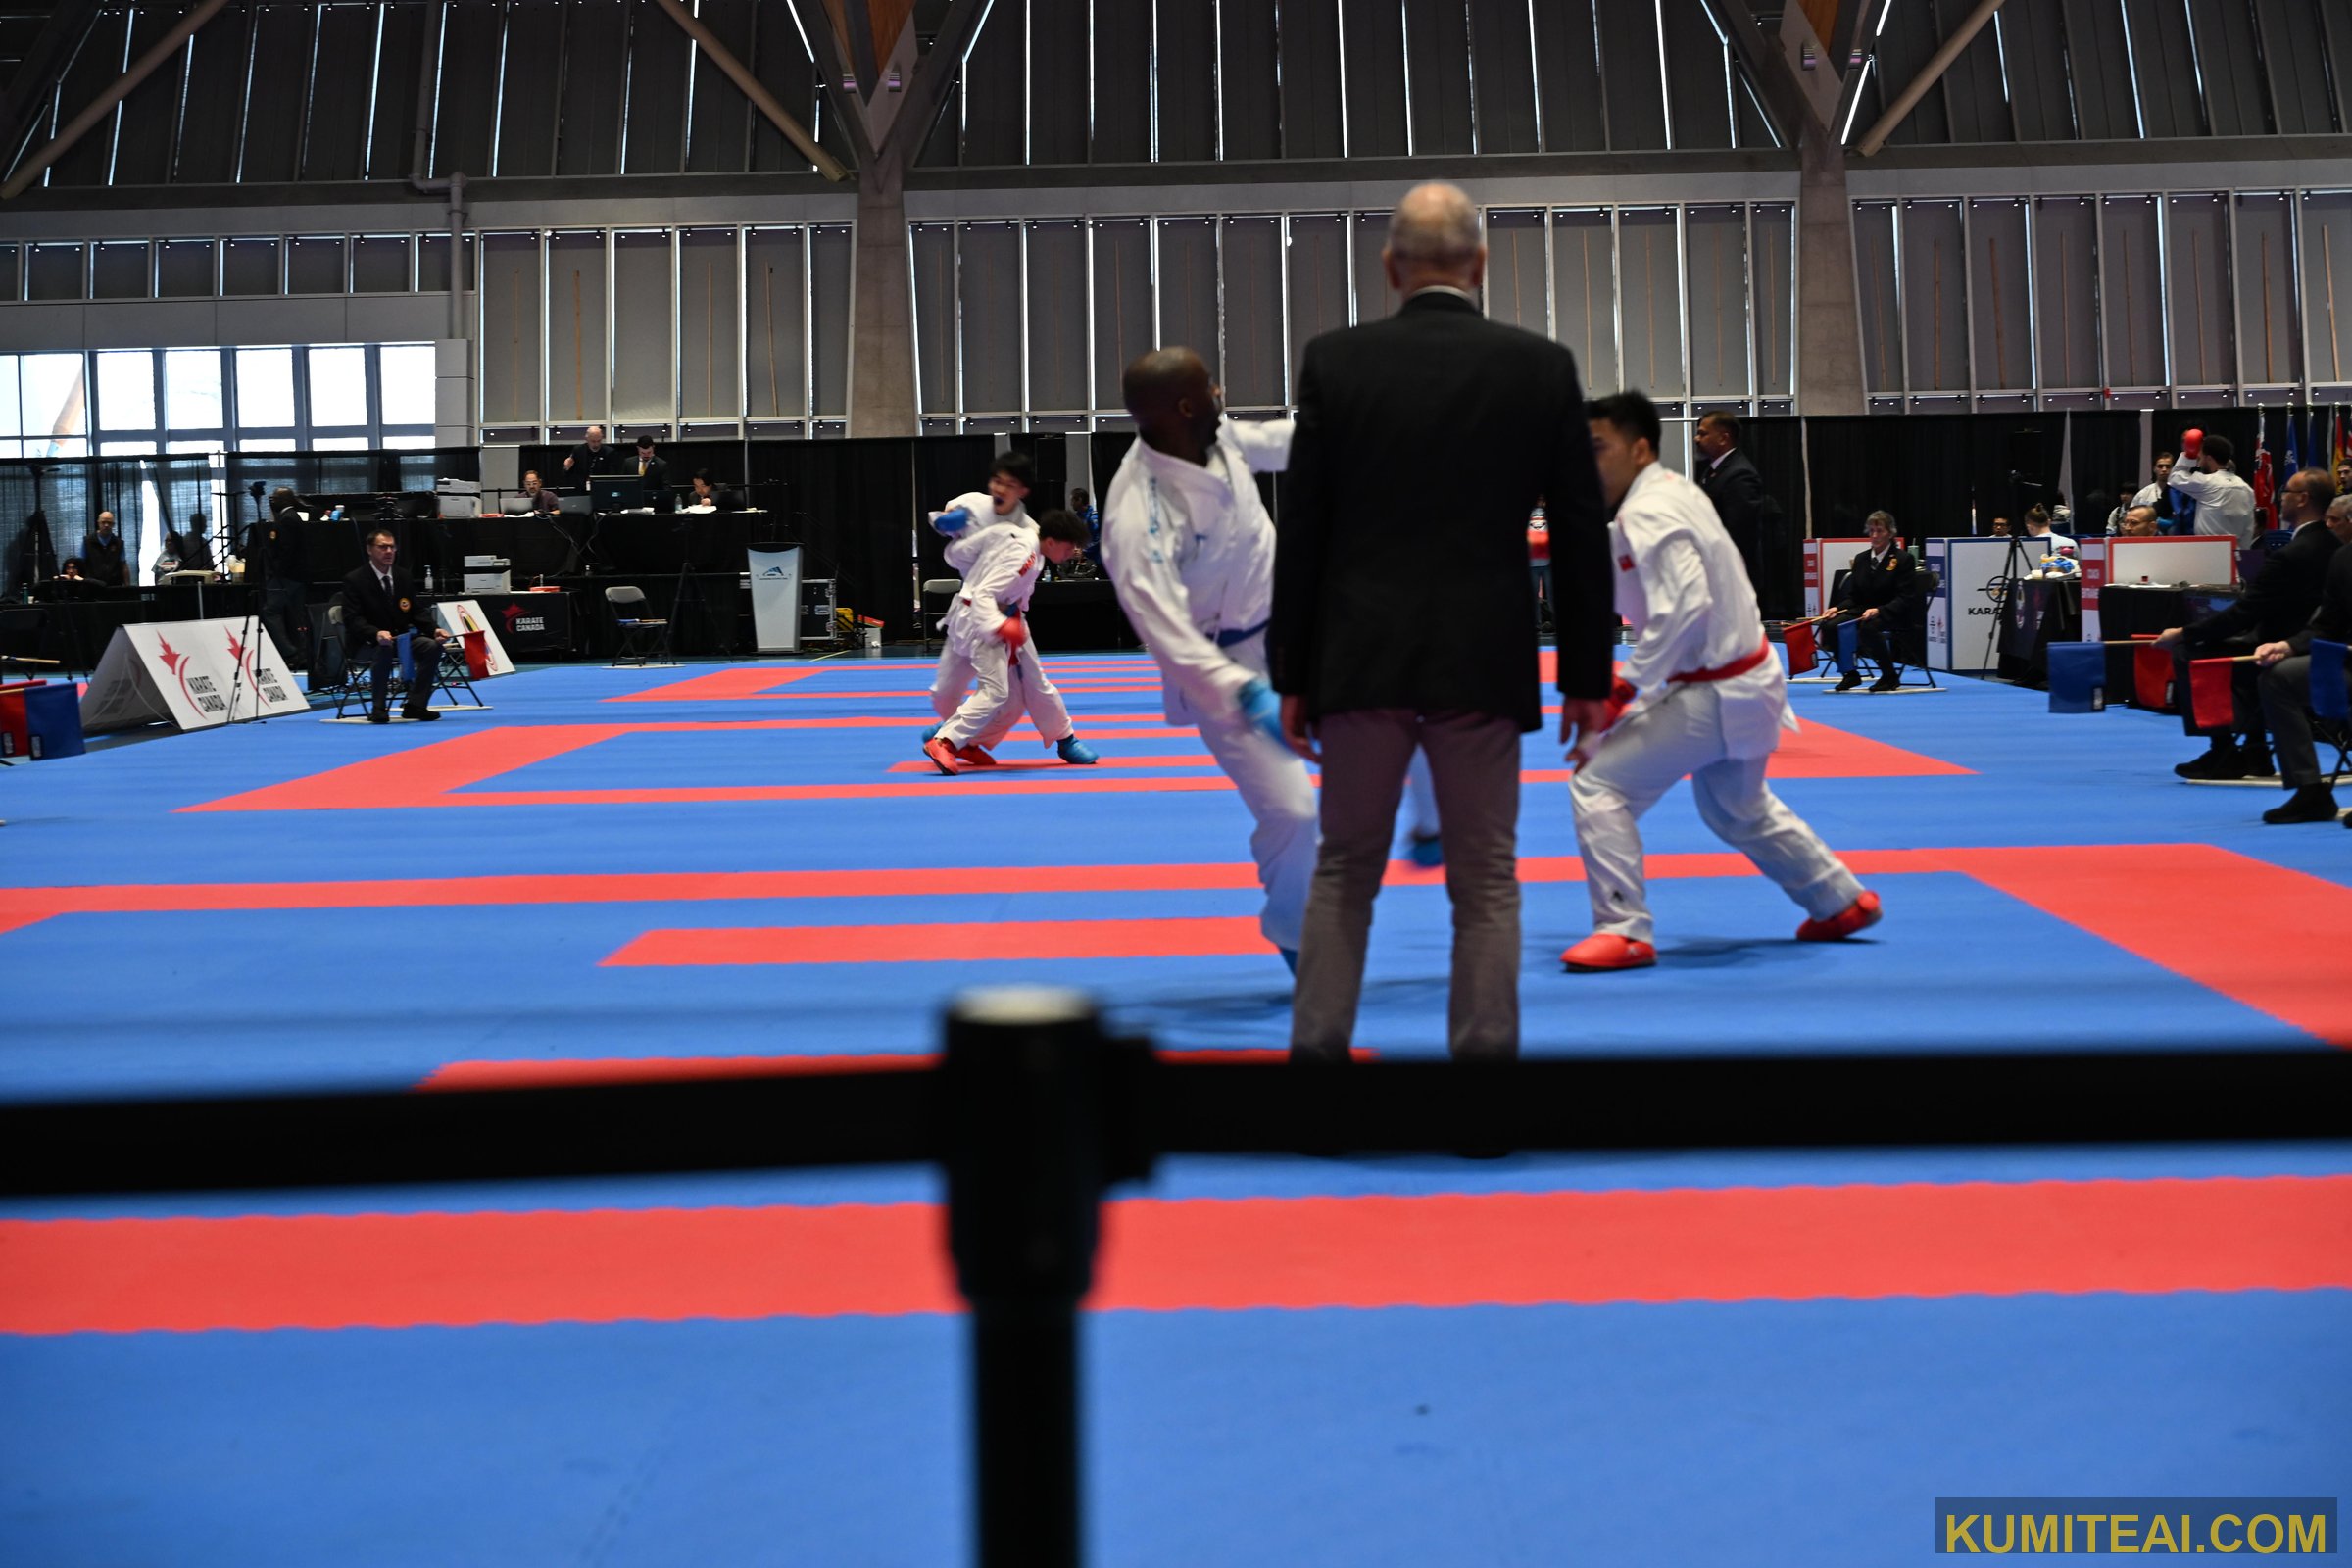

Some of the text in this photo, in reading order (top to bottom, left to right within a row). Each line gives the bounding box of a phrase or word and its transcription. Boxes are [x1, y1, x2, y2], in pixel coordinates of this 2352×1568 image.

[1968, 607, 2003, 615] KARA
[186, 675, 217, 694] KARATE
[197, 694, 228, 712] CANADA
[263, 685, 288, 703] CANADA
